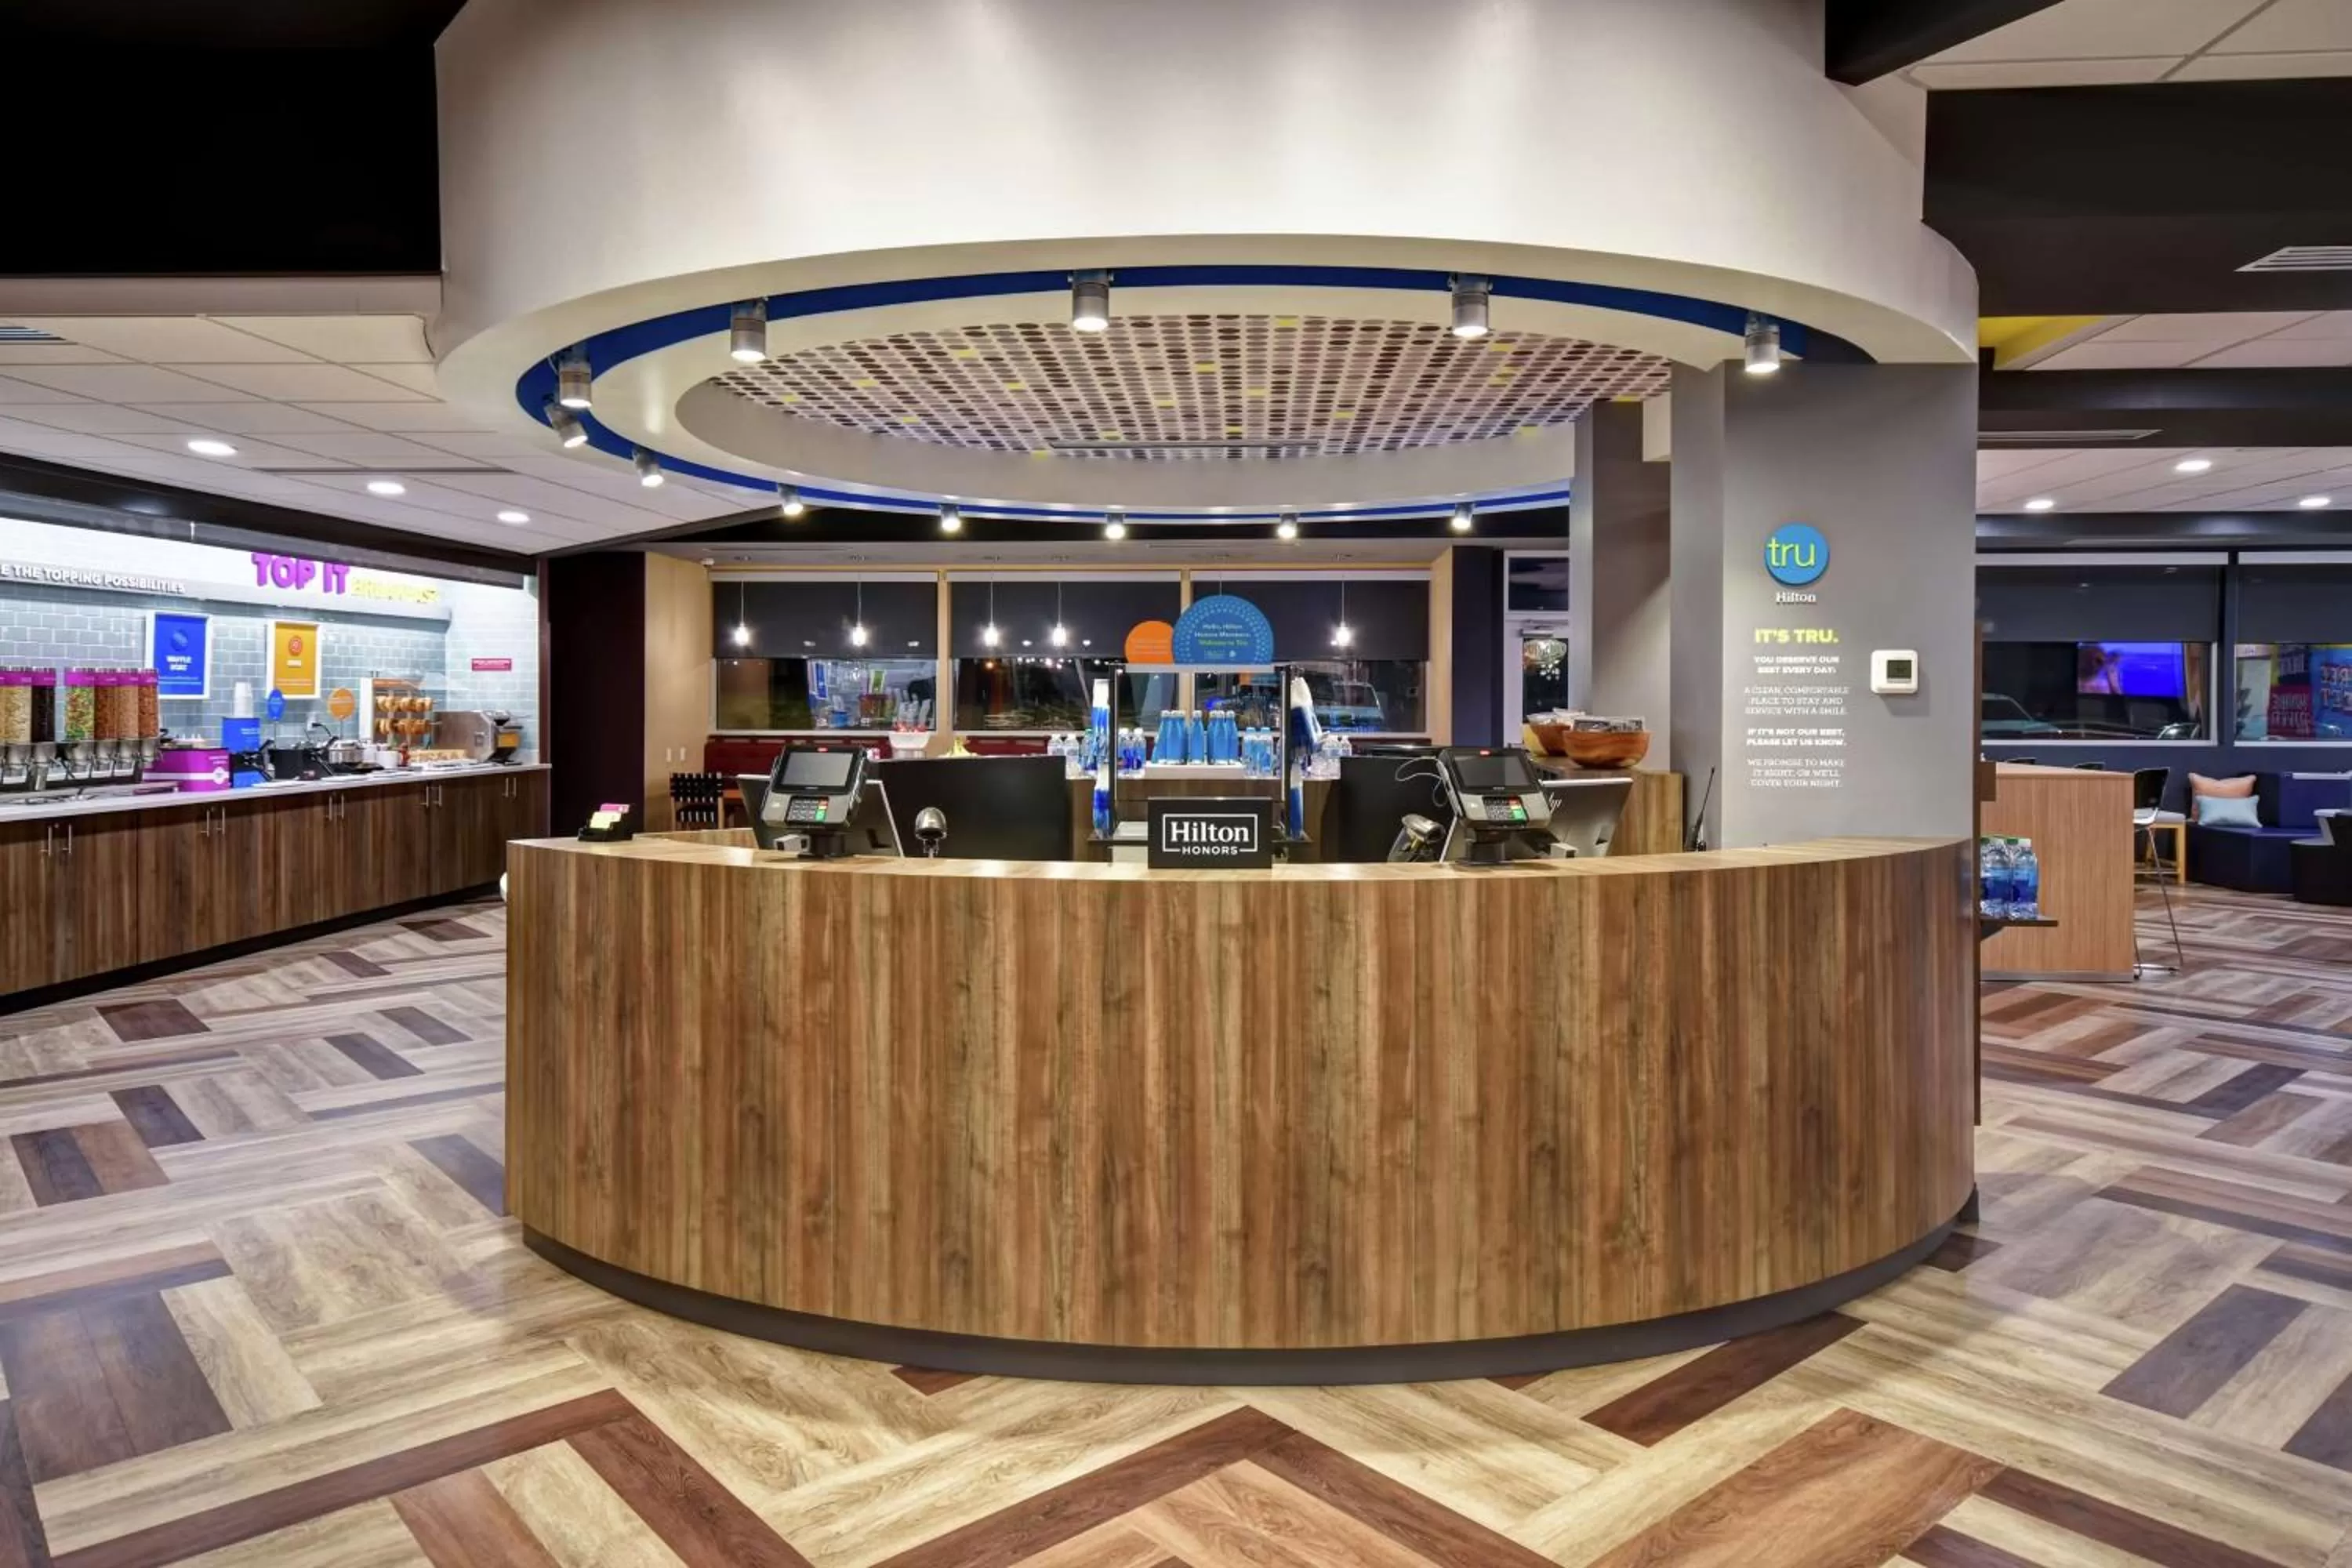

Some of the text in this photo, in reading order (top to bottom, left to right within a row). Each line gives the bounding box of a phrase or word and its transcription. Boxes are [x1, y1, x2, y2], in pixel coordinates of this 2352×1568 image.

[1767, 537, 1816, 567] tru
[13, 564, 39, 579] THE
[43, 568, 101, 586] TOPPING
[104, 575, 186, 593] POSSIBILITIES
[251, 551, 316, 590] TOP
[323, 561, 350, 594] IT
[1776, 591, 1817, 602] Hilton
[1755, 628, 1839, 643] IT'S TRU.
[1171, 821, 1250, 843] Hilton
[1181, 846, 1238, 855] HONORS
